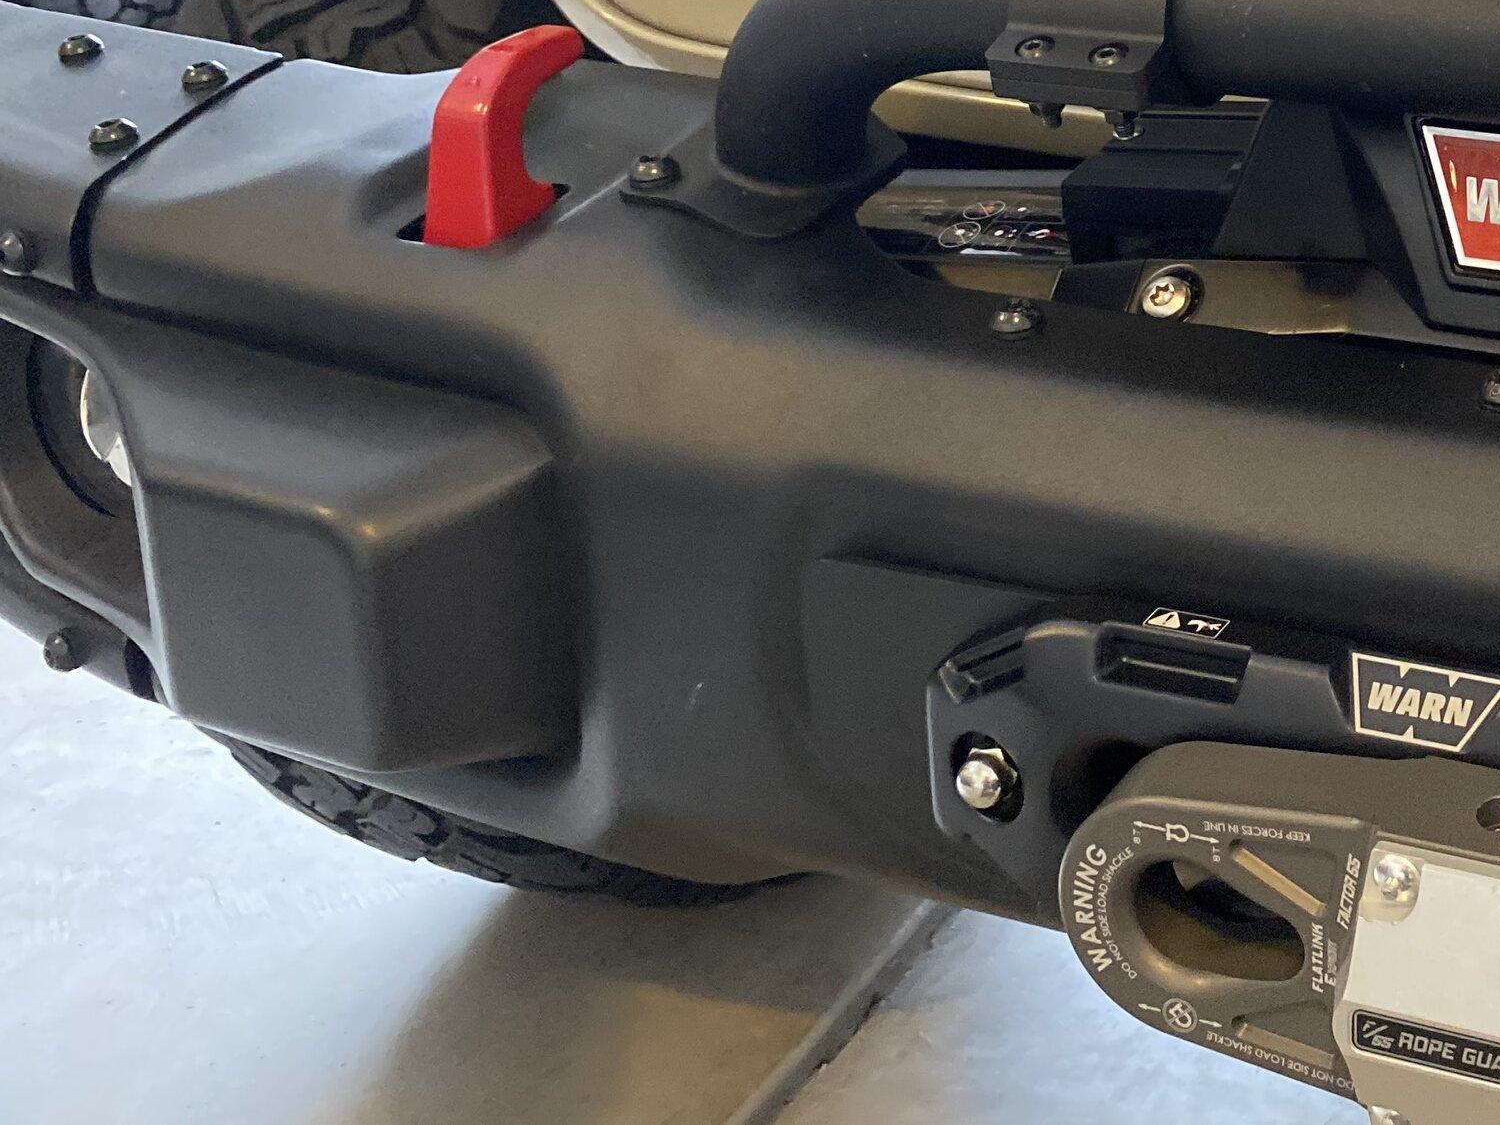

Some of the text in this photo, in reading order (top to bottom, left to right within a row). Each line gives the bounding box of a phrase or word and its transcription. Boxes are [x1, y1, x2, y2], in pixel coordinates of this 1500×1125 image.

[1367, 681, 1474, 728] WARN
[1203, 820, 1311, 842] KEEP FORCES IN LINE
[1073, 843, 1113, 972] WARNING
[1097, 846, 1138, 979] DO NOT SIDE LOAD SHACKLE
[1336, 874, 1358, 931] FACTOR
[1311, 921, 1324, 993] FLATLINK
[1206, 1030, 1253, 1055] SHACKLE
[1254, 1048, 1286, 1067] LOAD
[1398, 1031, 1458, 1061] ROPE
[1287, 1060, 1310, 1076] SIDE
[1310, 1068, 1336, 1084] NOT
